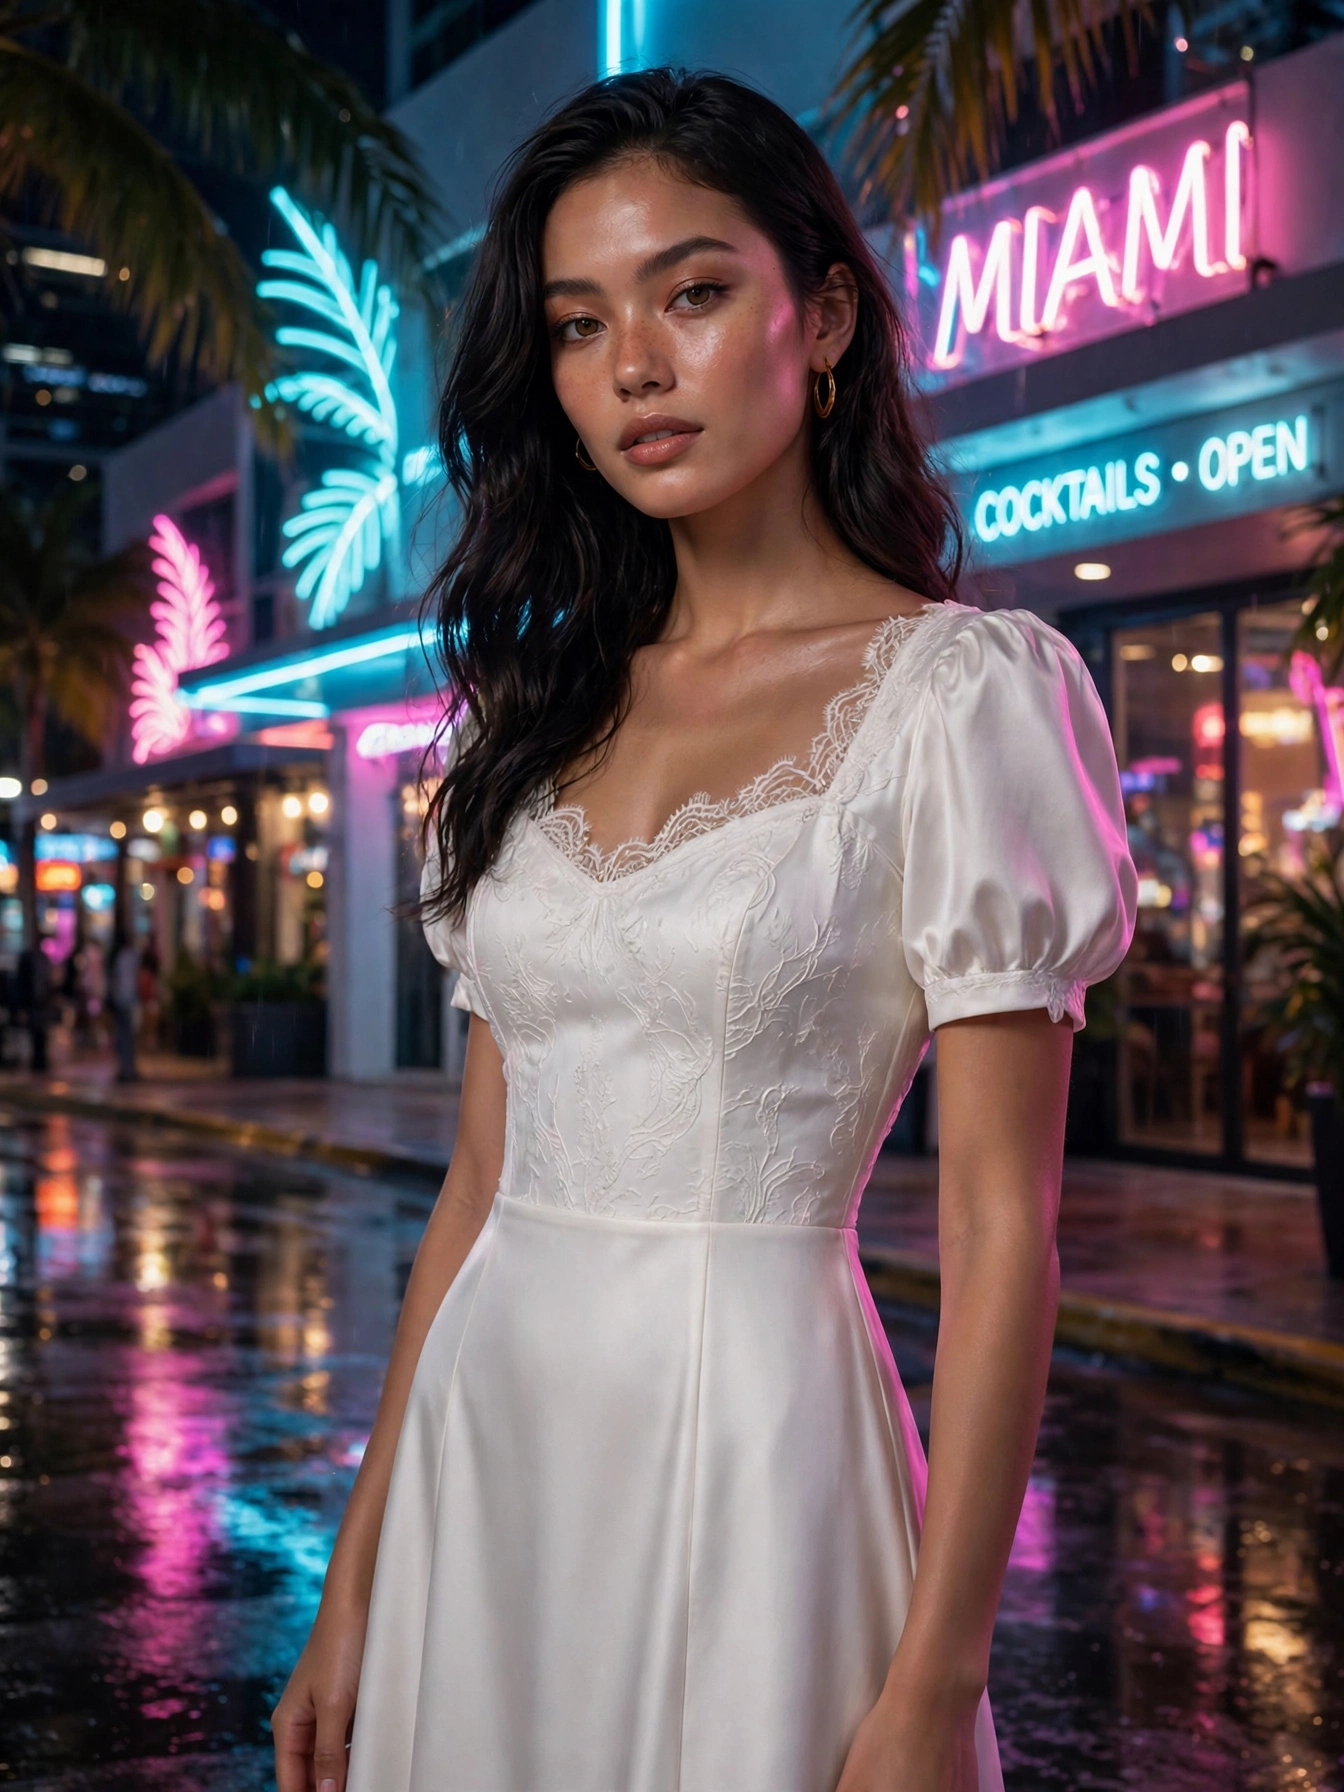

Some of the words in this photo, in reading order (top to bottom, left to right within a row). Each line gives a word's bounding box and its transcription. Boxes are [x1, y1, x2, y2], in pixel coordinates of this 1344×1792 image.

[933, 121, 1249, 368] MIAMI
[975, 452, 1161, 541] COCKTAILS
[1199, 415, 1307, 491] OPEN
